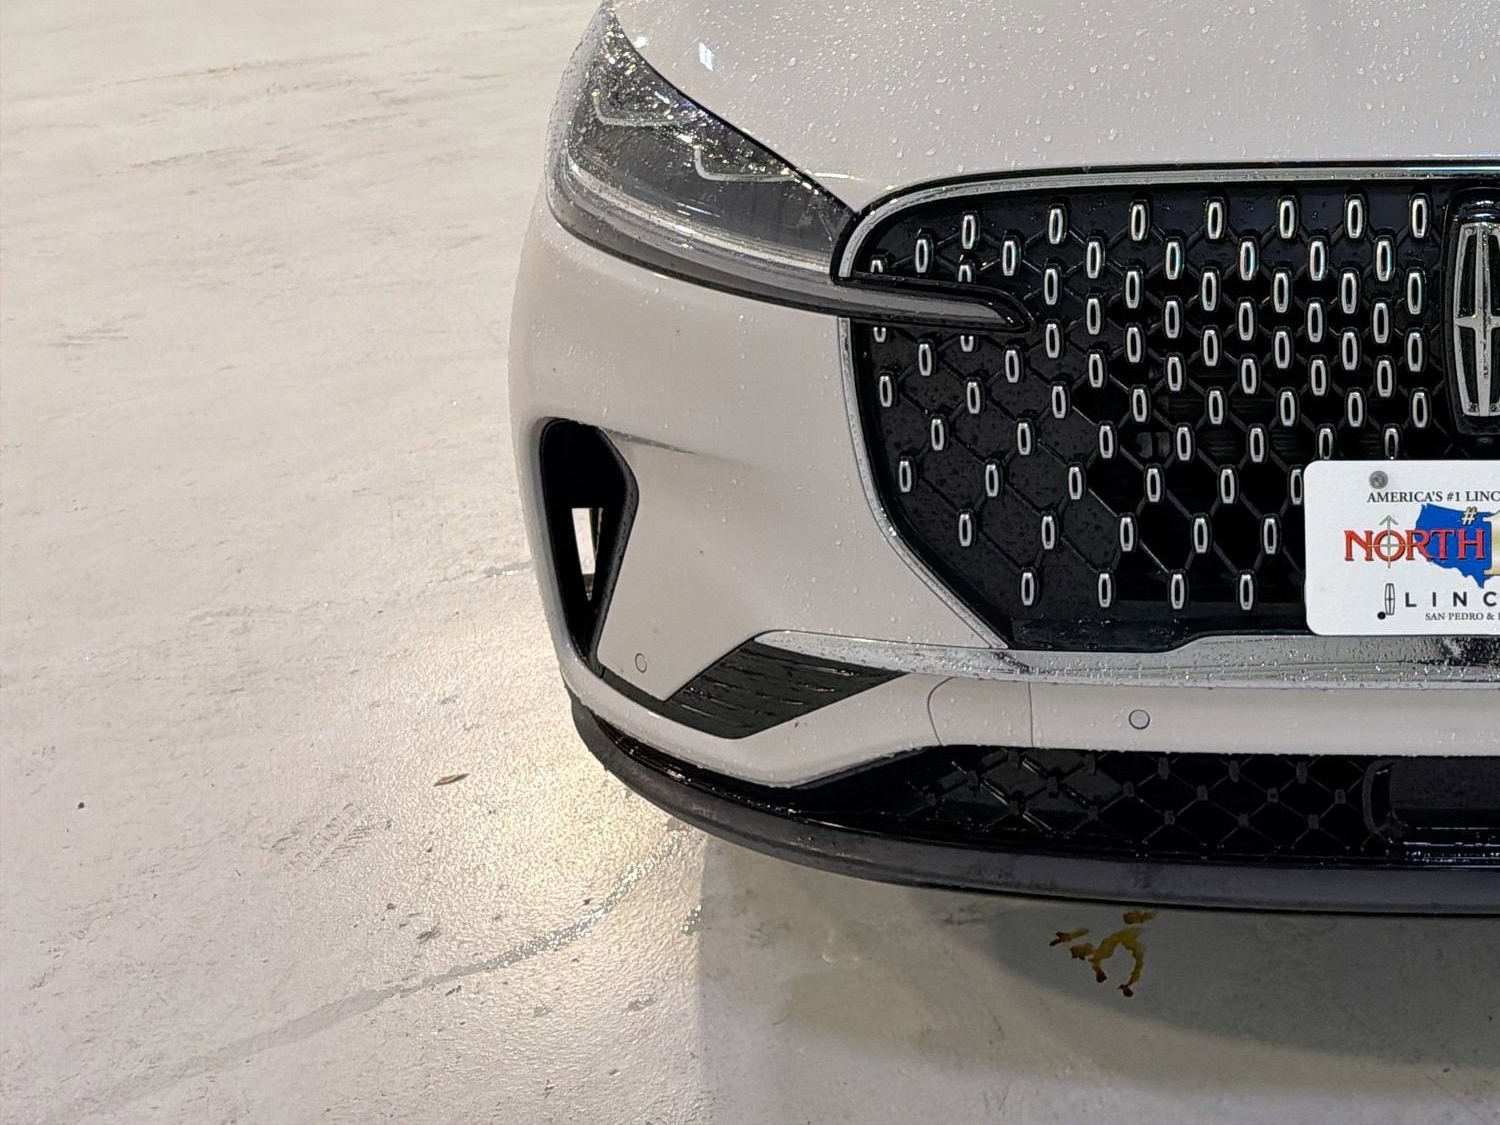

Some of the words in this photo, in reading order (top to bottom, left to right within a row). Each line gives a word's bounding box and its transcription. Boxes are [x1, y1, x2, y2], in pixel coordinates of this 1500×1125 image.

[1367, 490, 1443, 503] AMERICA'S
[1446, 491, 1461, 502] #1
[1343, 529, 1486, 562] NORTH
[1425, 612, 1445, 621] SAN
[1449, 612, 1485, 621] PEDRO
[1487, 613, 1495, 621] &
